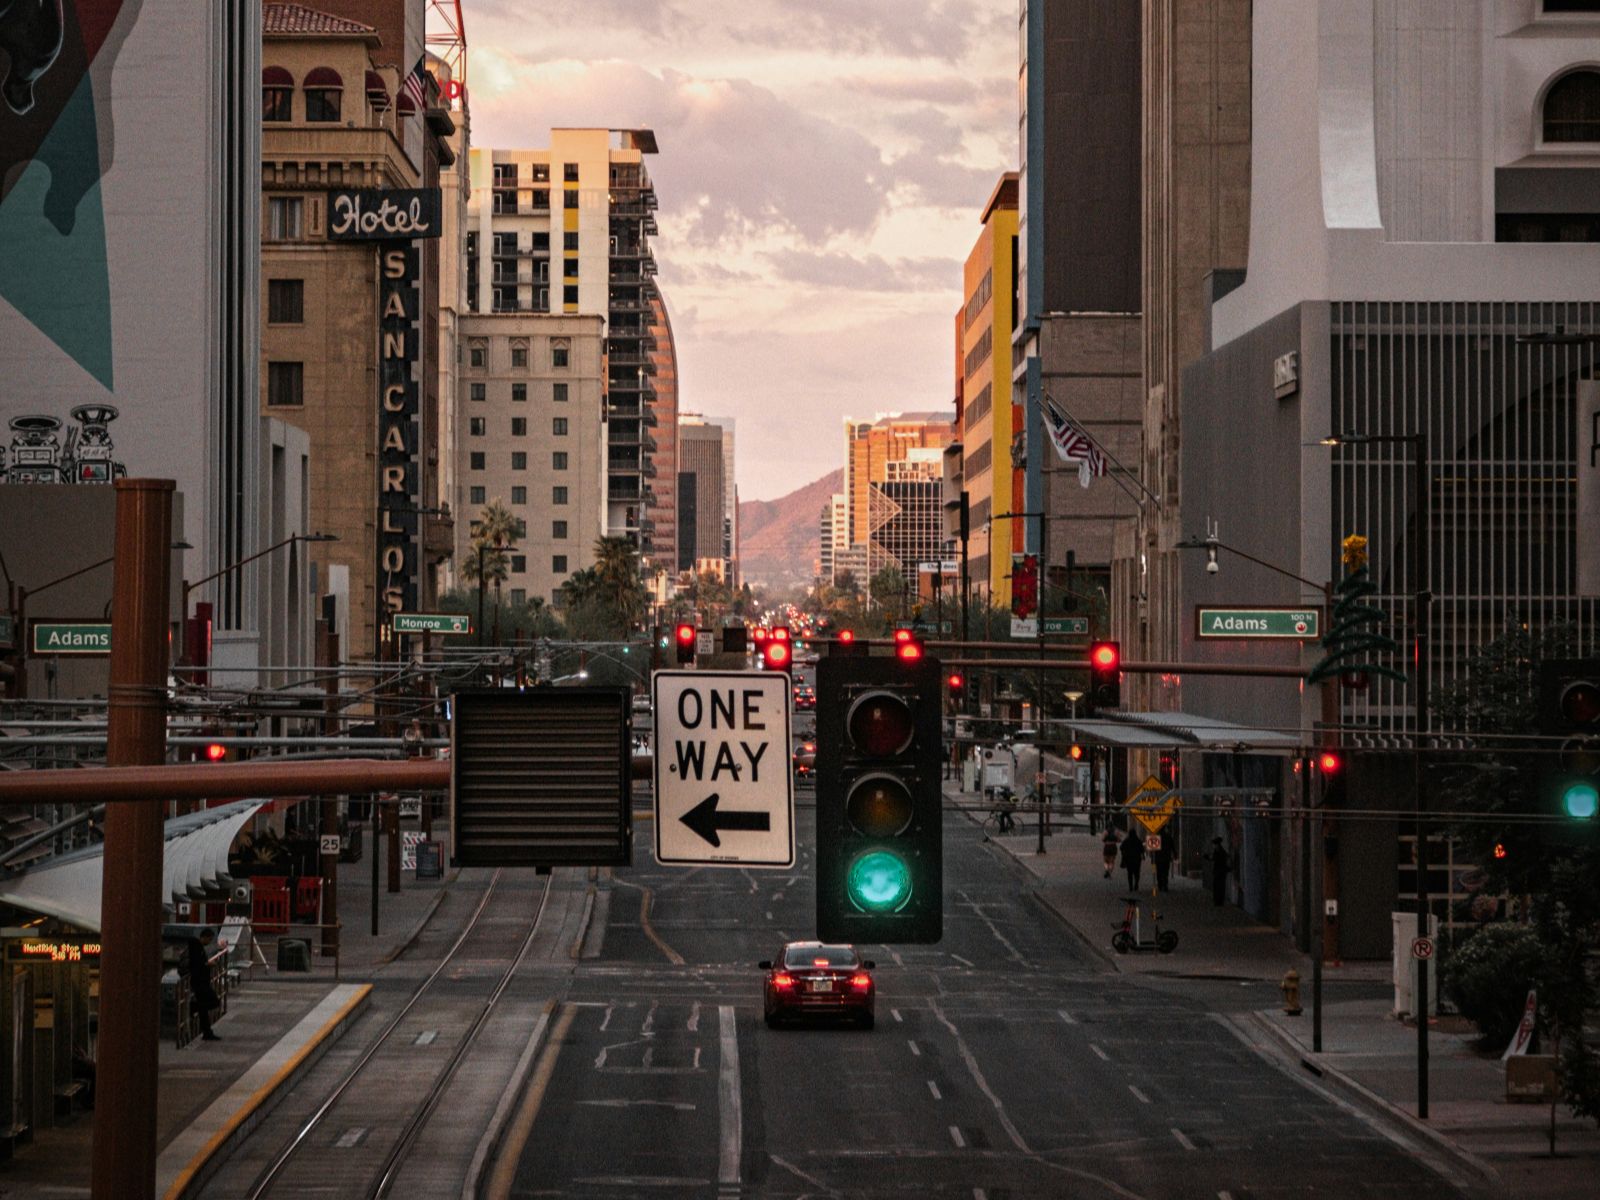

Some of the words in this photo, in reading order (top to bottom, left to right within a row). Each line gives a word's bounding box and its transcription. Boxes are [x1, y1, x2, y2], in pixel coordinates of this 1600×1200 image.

[332, 193, 429, 235] Hotel
[384, 250, 407, 360] SAN
[383, 384, 406, 613] CARLOS
[48, 631, 109, 646] Adams
[401, 618, 441, 629] Monroe
[1212, 616, 1268, 630] Adams
[678, 688, 766, 730] ONE
[675, 741, 769, 782] WAY
[323, 839, 338, 850] 25
